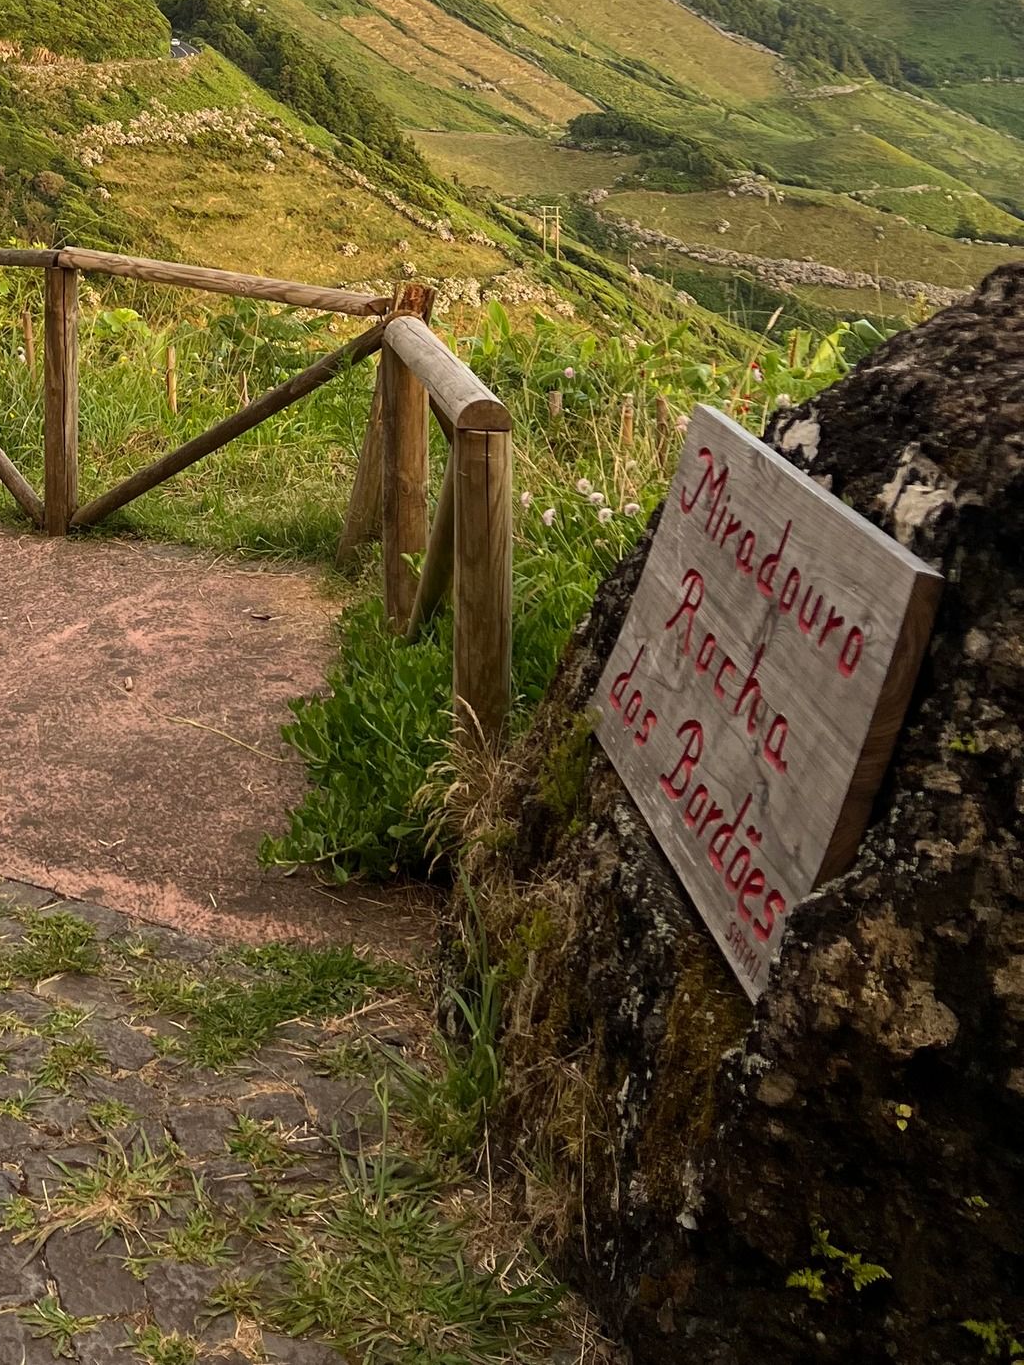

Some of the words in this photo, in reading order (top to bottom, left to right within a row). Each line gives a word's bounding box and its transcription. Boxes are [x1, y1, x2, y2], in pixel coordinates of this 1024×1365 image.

[665, 568, 788, 774] Rocha
[681, 446, 864, 678] Miradouro
[609, 644, 657, 746] dos
[660, 719, 786, 942] Bordões
